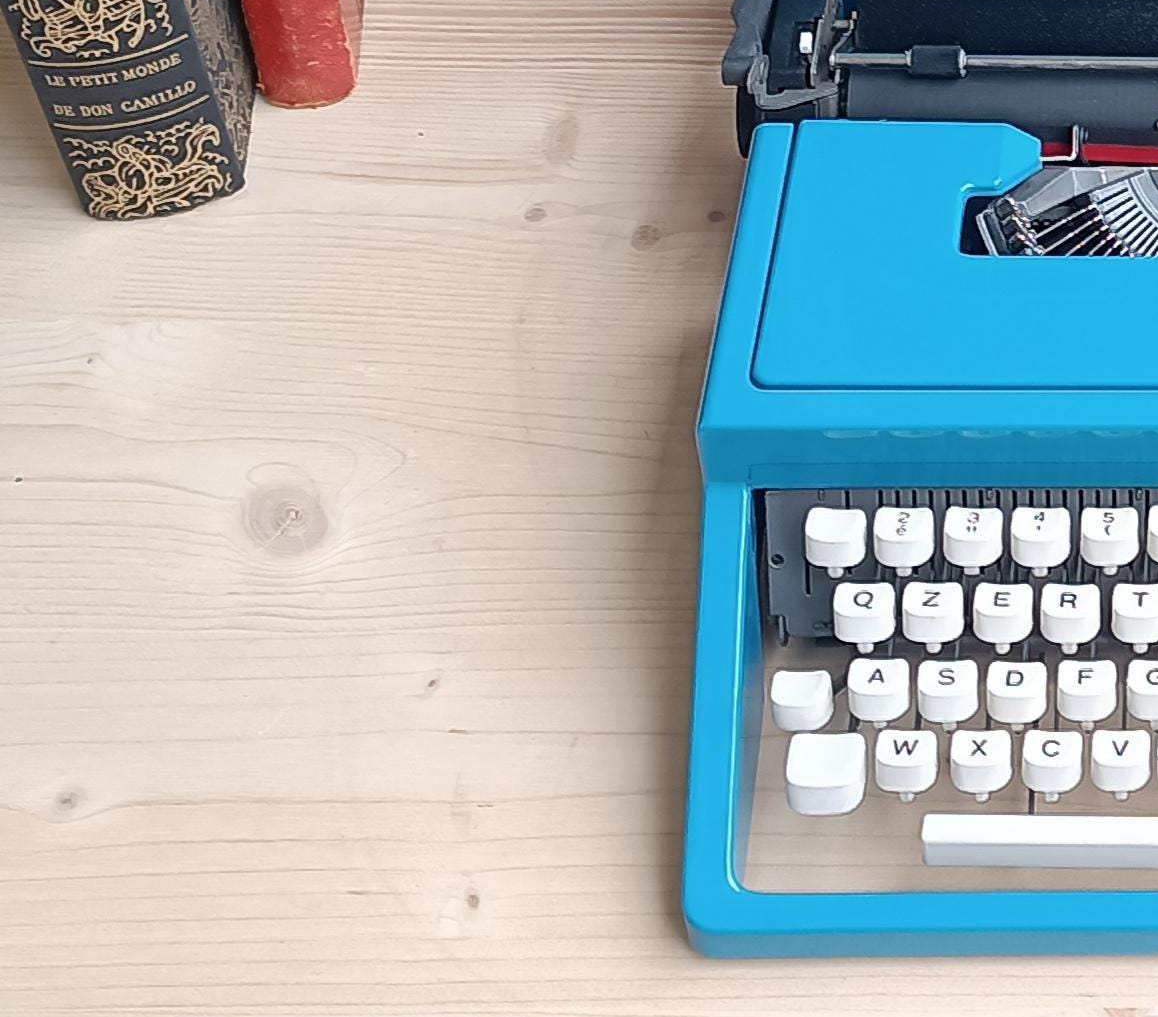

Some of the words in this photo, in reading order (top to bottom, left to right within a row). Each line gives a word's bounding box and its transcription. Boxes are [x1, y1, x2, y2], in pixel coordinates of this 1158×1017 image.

[45, 74, 66, 88] LE
[69, 71, 119, 87] PETIT
[122, 52, 182, 81] MONDE
[53, 104, 76, 117] DE
[80, 103, 114, 117] DON
[121, 80, 197, 113] CAMILLO
[852, 589, 874, 610] Q
[921, 591, 941, 608] Z
[993, 591, 1011, 608] E
[1059, 591, 1078, 609] R
[1132, 591, 1150, 608] T
[867, 668, 885, 684] A
[937, 667, 956, 686] S
[1005, 669, 1025, 687] D
[1077, 667, 1094, 685] F
[893, 739, 919, 756] W
[970, 739, 988, 757] X
[1041, 739, 1061, 758] C
[1111, 739, 1129, 757] V
